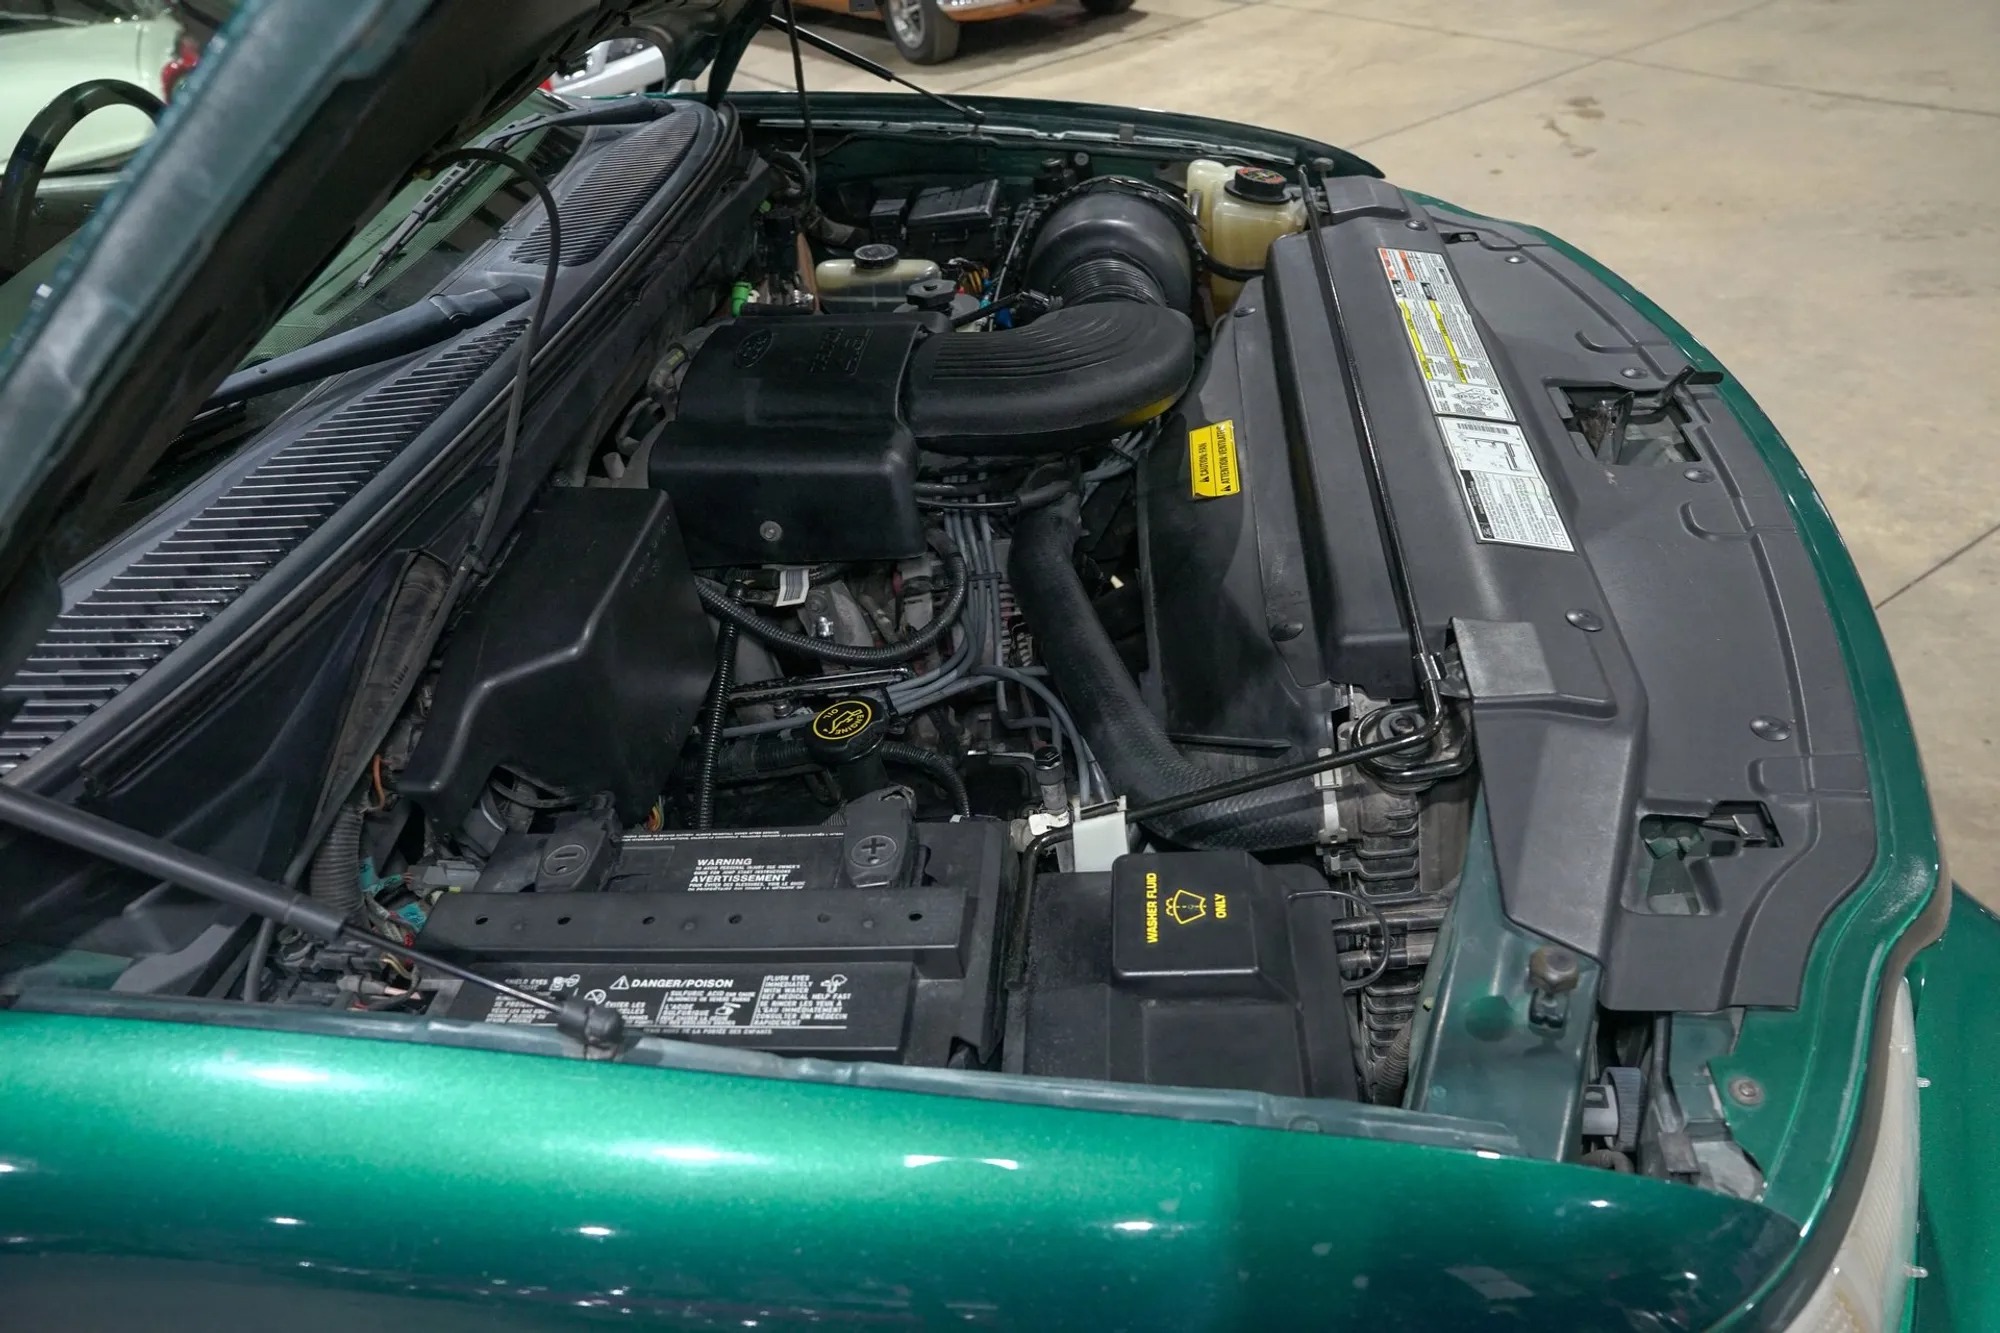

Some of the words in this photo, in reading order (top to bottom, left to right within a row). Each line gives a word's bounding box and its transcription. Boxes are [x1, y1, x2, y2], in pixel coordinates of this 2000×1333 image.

[823, 708, 839, 719] OIL
[835, 714, 865, 735] ENGINE
[697, 858, 752, 866] WARNING
[690, 874, 789, 883] AVERTISSEMENT
[1146, 872, 1158, 899] FLUID
[1214, 893, 1227, 918] ONLY
[1146, 901, 1159, 943] WASHER
[631, 979, 734, 988] DANGER/POISON
